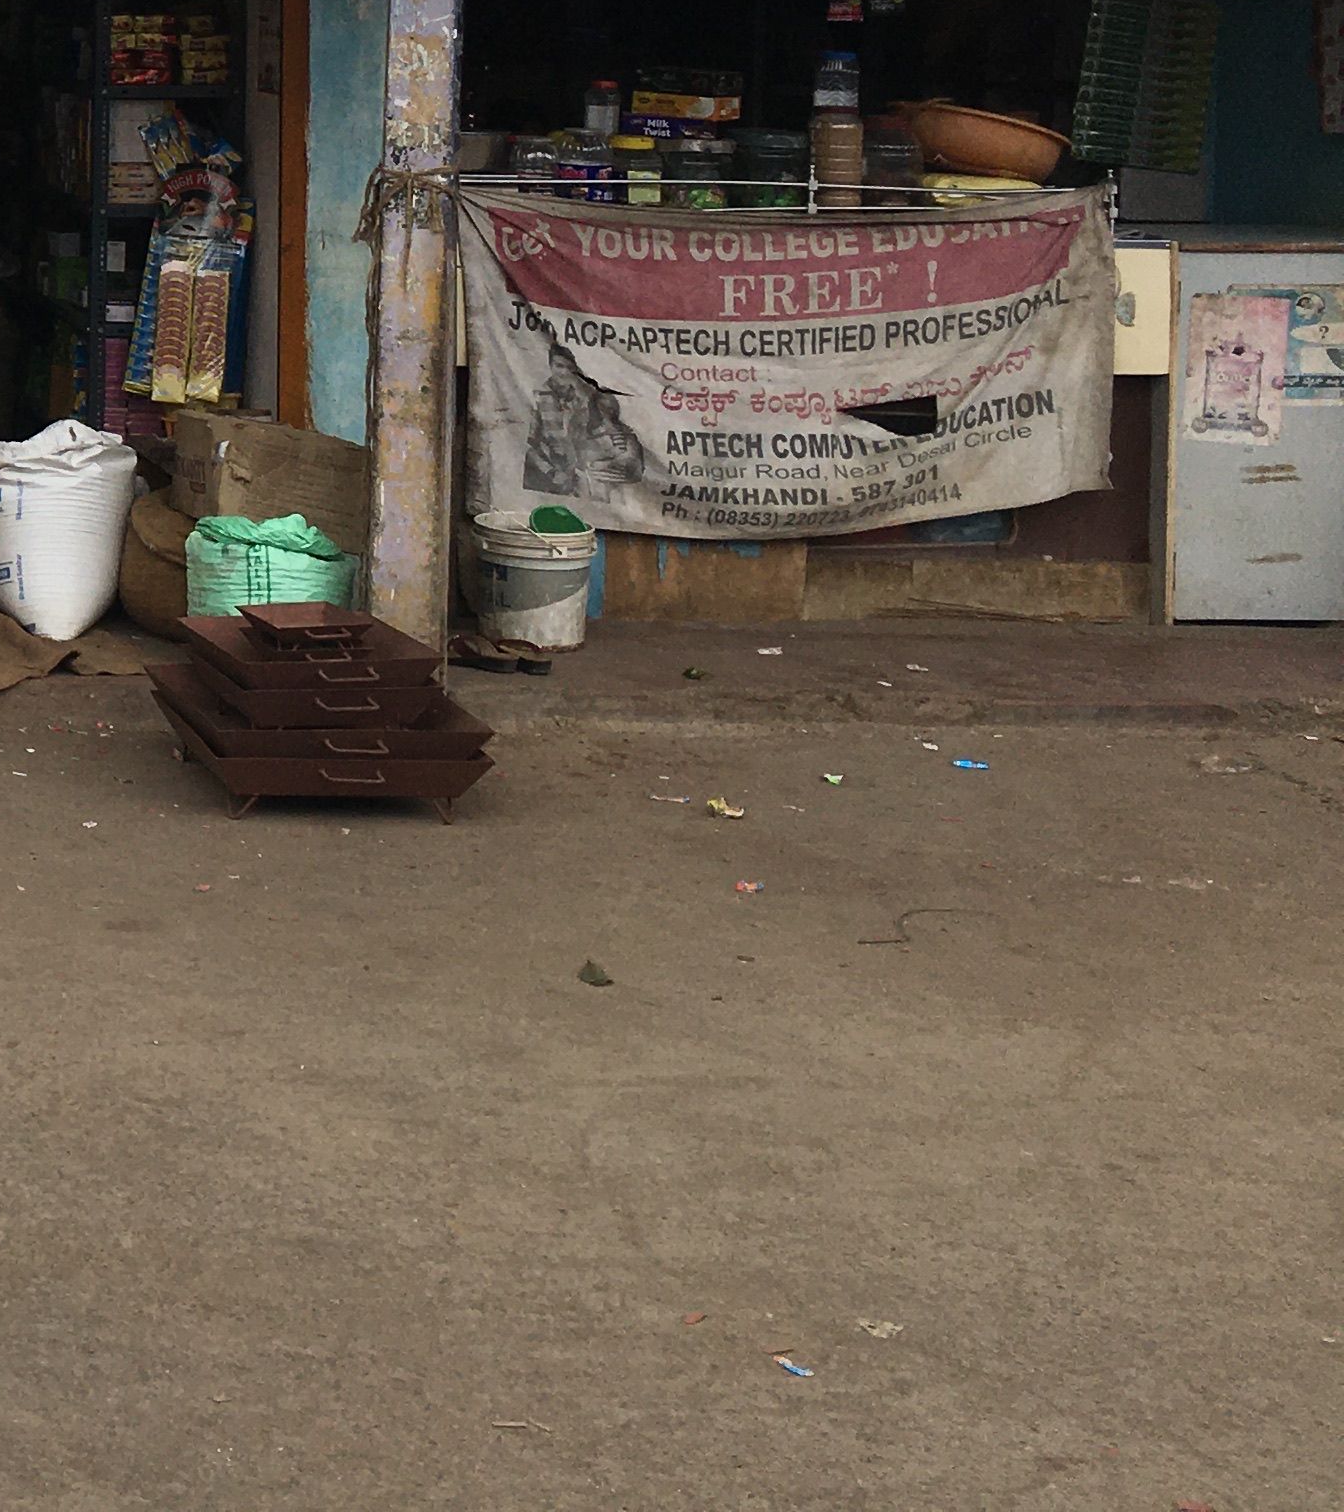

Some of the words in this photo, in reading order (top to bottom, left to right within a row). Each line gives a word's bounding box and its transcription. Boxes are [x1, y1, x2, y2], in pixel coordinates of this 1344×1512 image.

[643, 128, 671, 138] Twist
[647, 119, 669, 128] Milk
[167, 174, 194, 193] HIGH
[502, 218, 555, 262] Get
[569, 222, 677, 261] YOUR
[688, 229, 859, 262] COLLEGE
[564, 317, 730, 356] ACP-APTECH
[740, 323, 875, 357] CERTIFIED
[885, 279, 1070, 348] PROFESSIONAL
[661, 362, 758, 383] Contact
[666, 430, 764, 458] APTECH
[755, 464, 828, 482] Road,
[834, 461, 890, 479] Near
[964, 426, 1032, 448] Circle
[661, 483, 828, 506] JAMKHANDI
[852, 479, 896, 503] 587
[903, 464, 939, 488] 301
